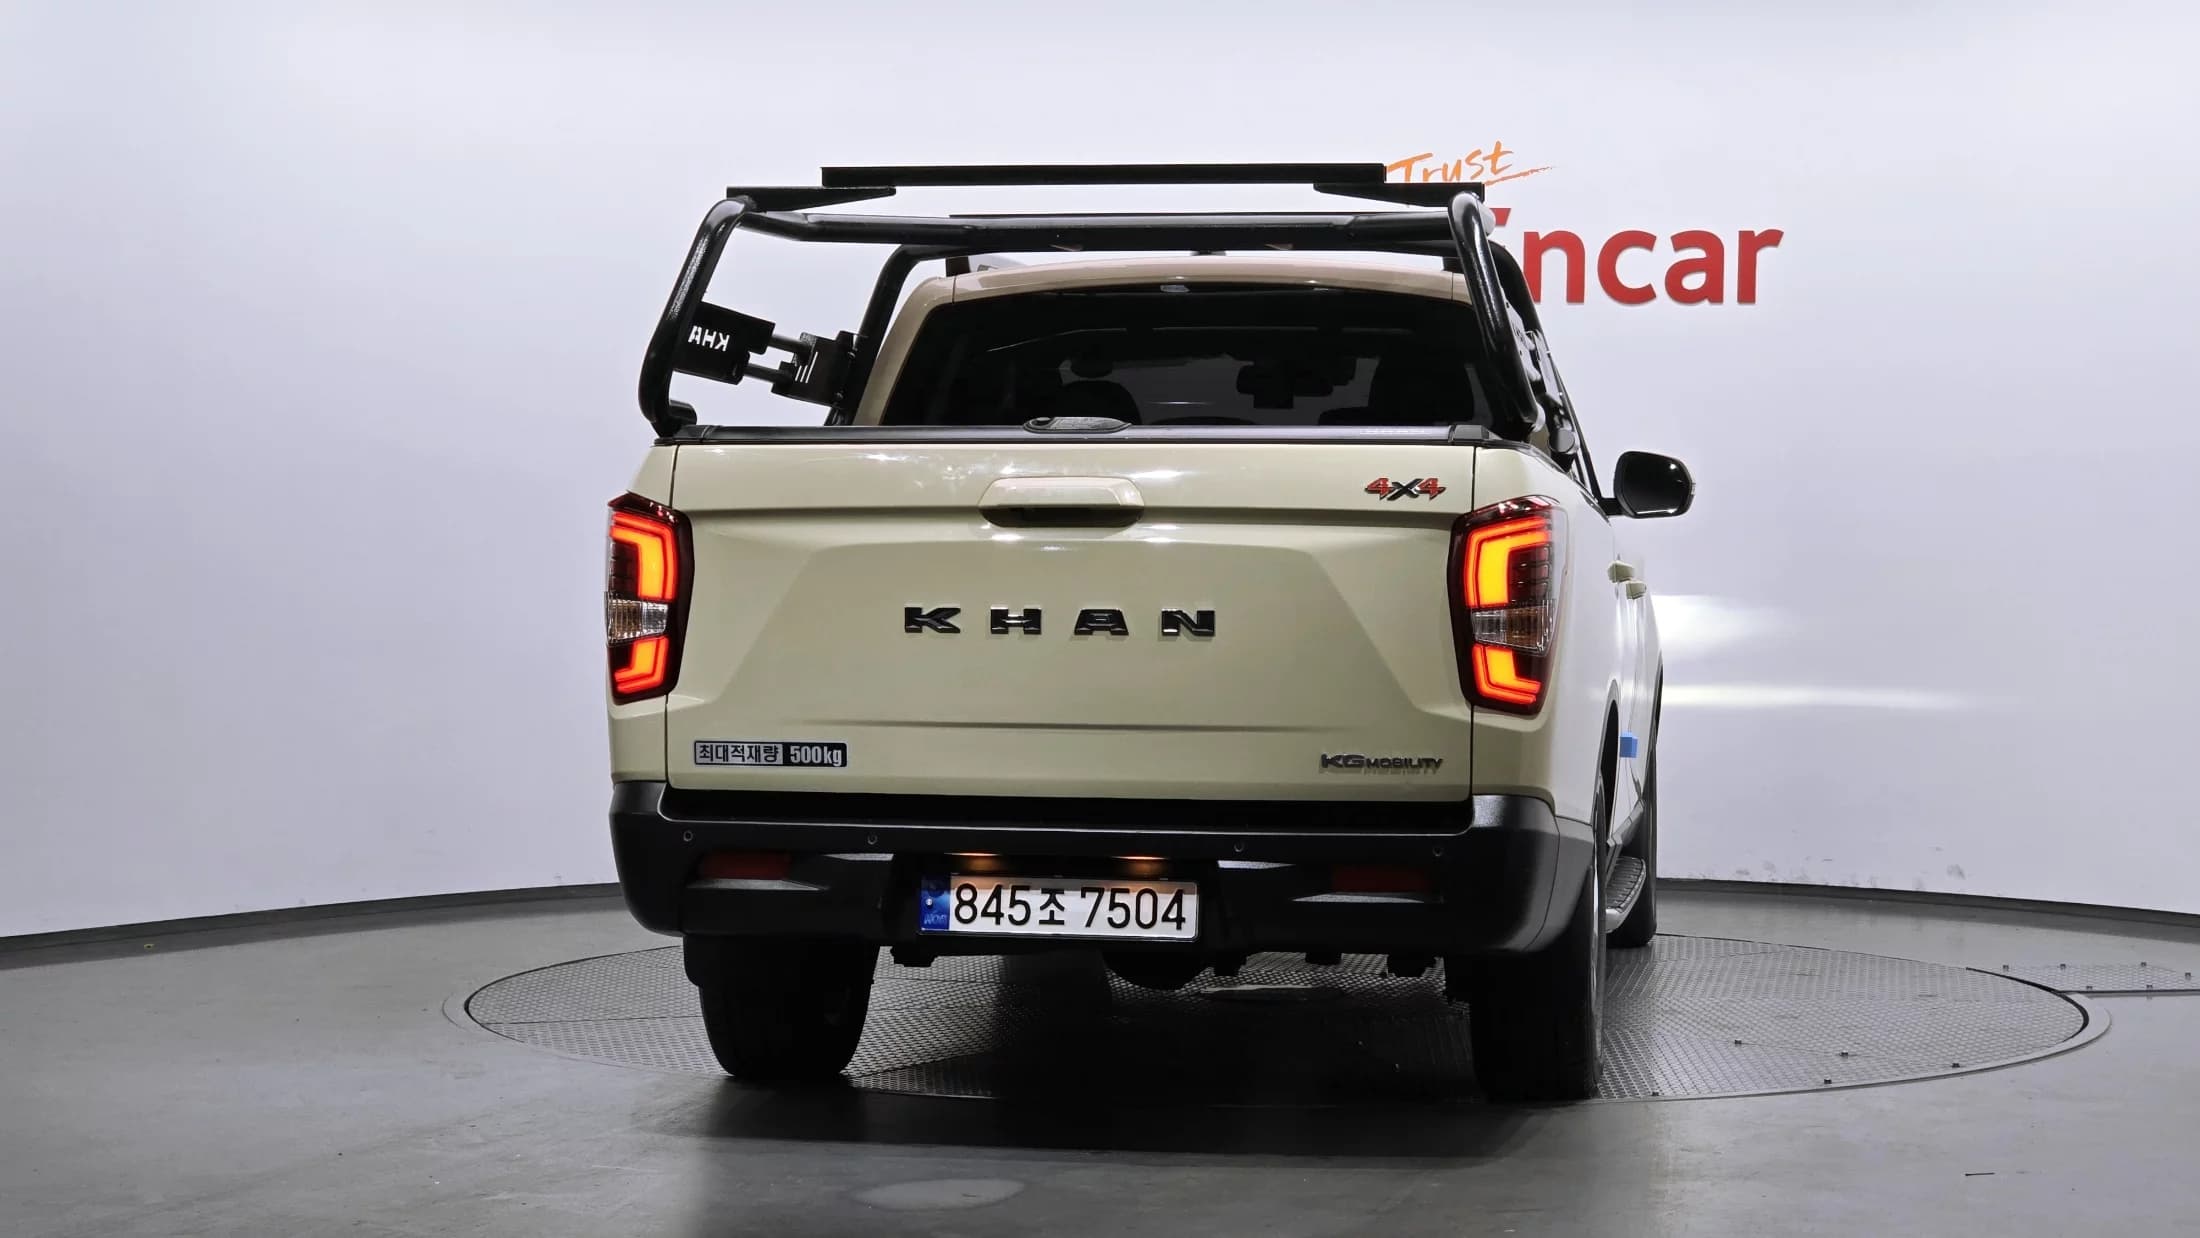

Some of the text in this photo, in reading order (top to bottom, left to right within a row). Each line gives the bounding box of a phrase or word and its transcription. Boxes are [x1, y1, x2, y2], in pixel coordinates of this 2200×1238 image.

[1387, 141, 1513, 182] Trust
[1494, 207, 1784, 305] ncar
[904, 606, 1215, 636] KHAN
[699, 744, 842, 766] 최대적재량 500kg
[1320, 754, 1443, 768] KG MOBILITY
[954, 883, 1186, 930] 845조 7504
